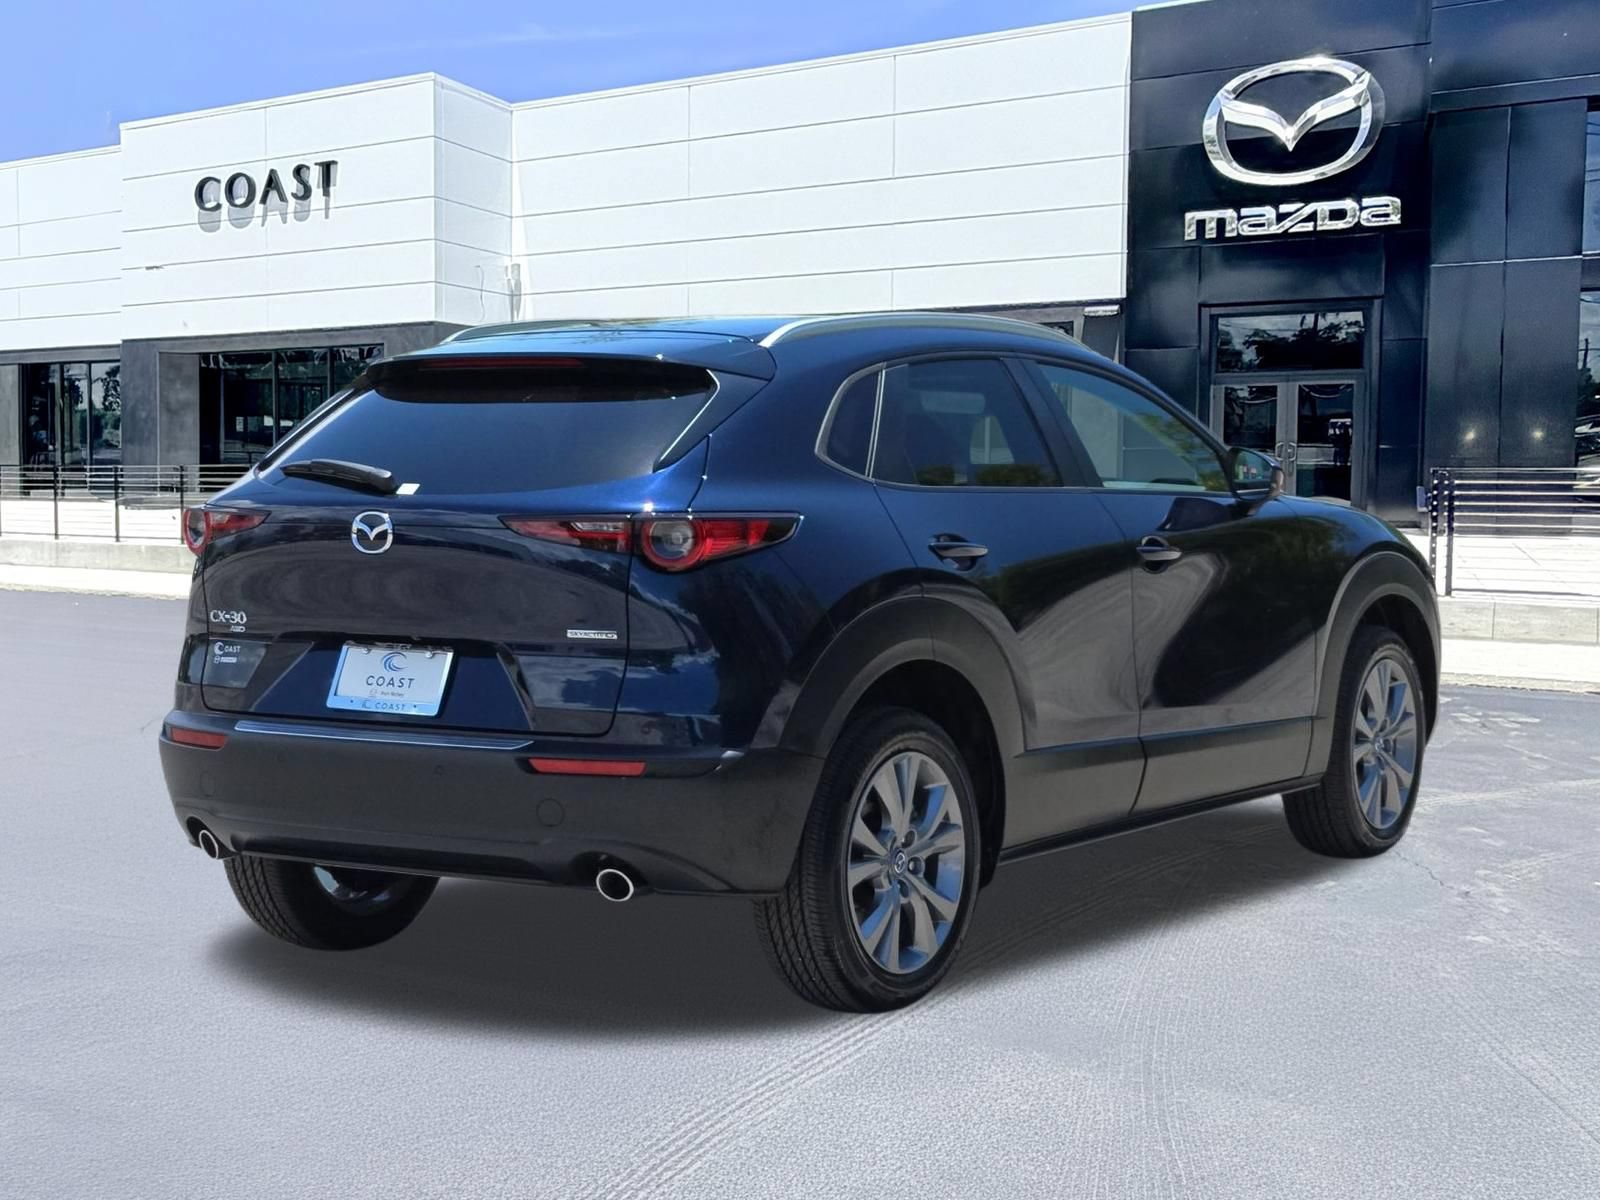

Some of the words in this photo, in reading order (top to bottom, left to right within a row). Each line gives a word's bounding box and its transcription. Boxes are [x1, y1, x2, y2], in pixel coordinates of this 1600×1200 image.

[194, 159, 338, 212] COAST
[210, 609, 248, 624] CX-30
[366, 675, 415, 689] COAST
[375, 702, 405, 711] COAST
